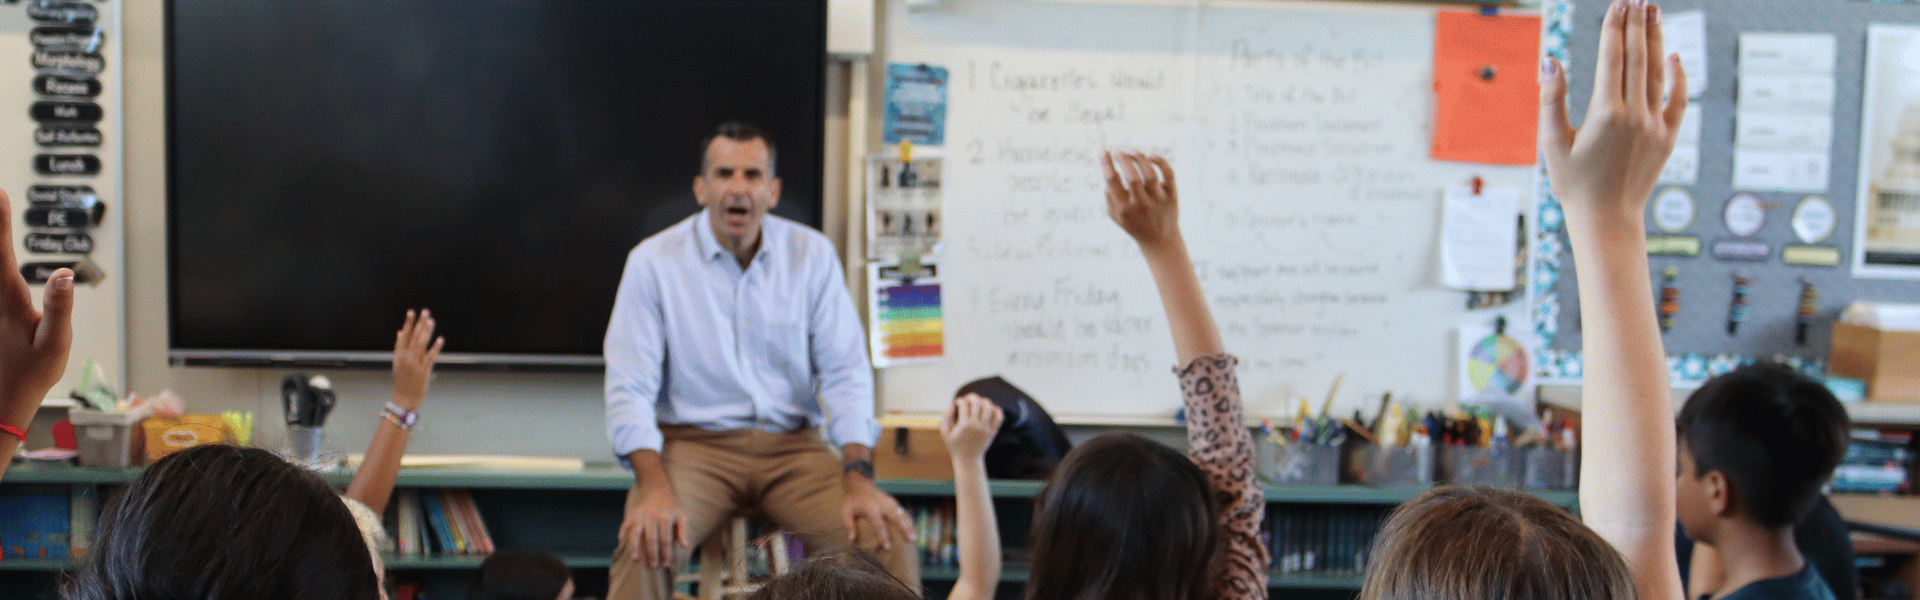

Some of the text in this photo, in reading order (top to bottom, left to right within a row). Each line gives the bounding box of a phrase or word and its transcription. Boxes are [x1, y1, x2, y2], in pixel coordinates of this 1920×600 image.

[45, 77, 89, 95] Recess
[49, 157, 85, 173] Lunch
[47, 210, 67, 226] PE
[28, 236, 89, 253] Friday Club
